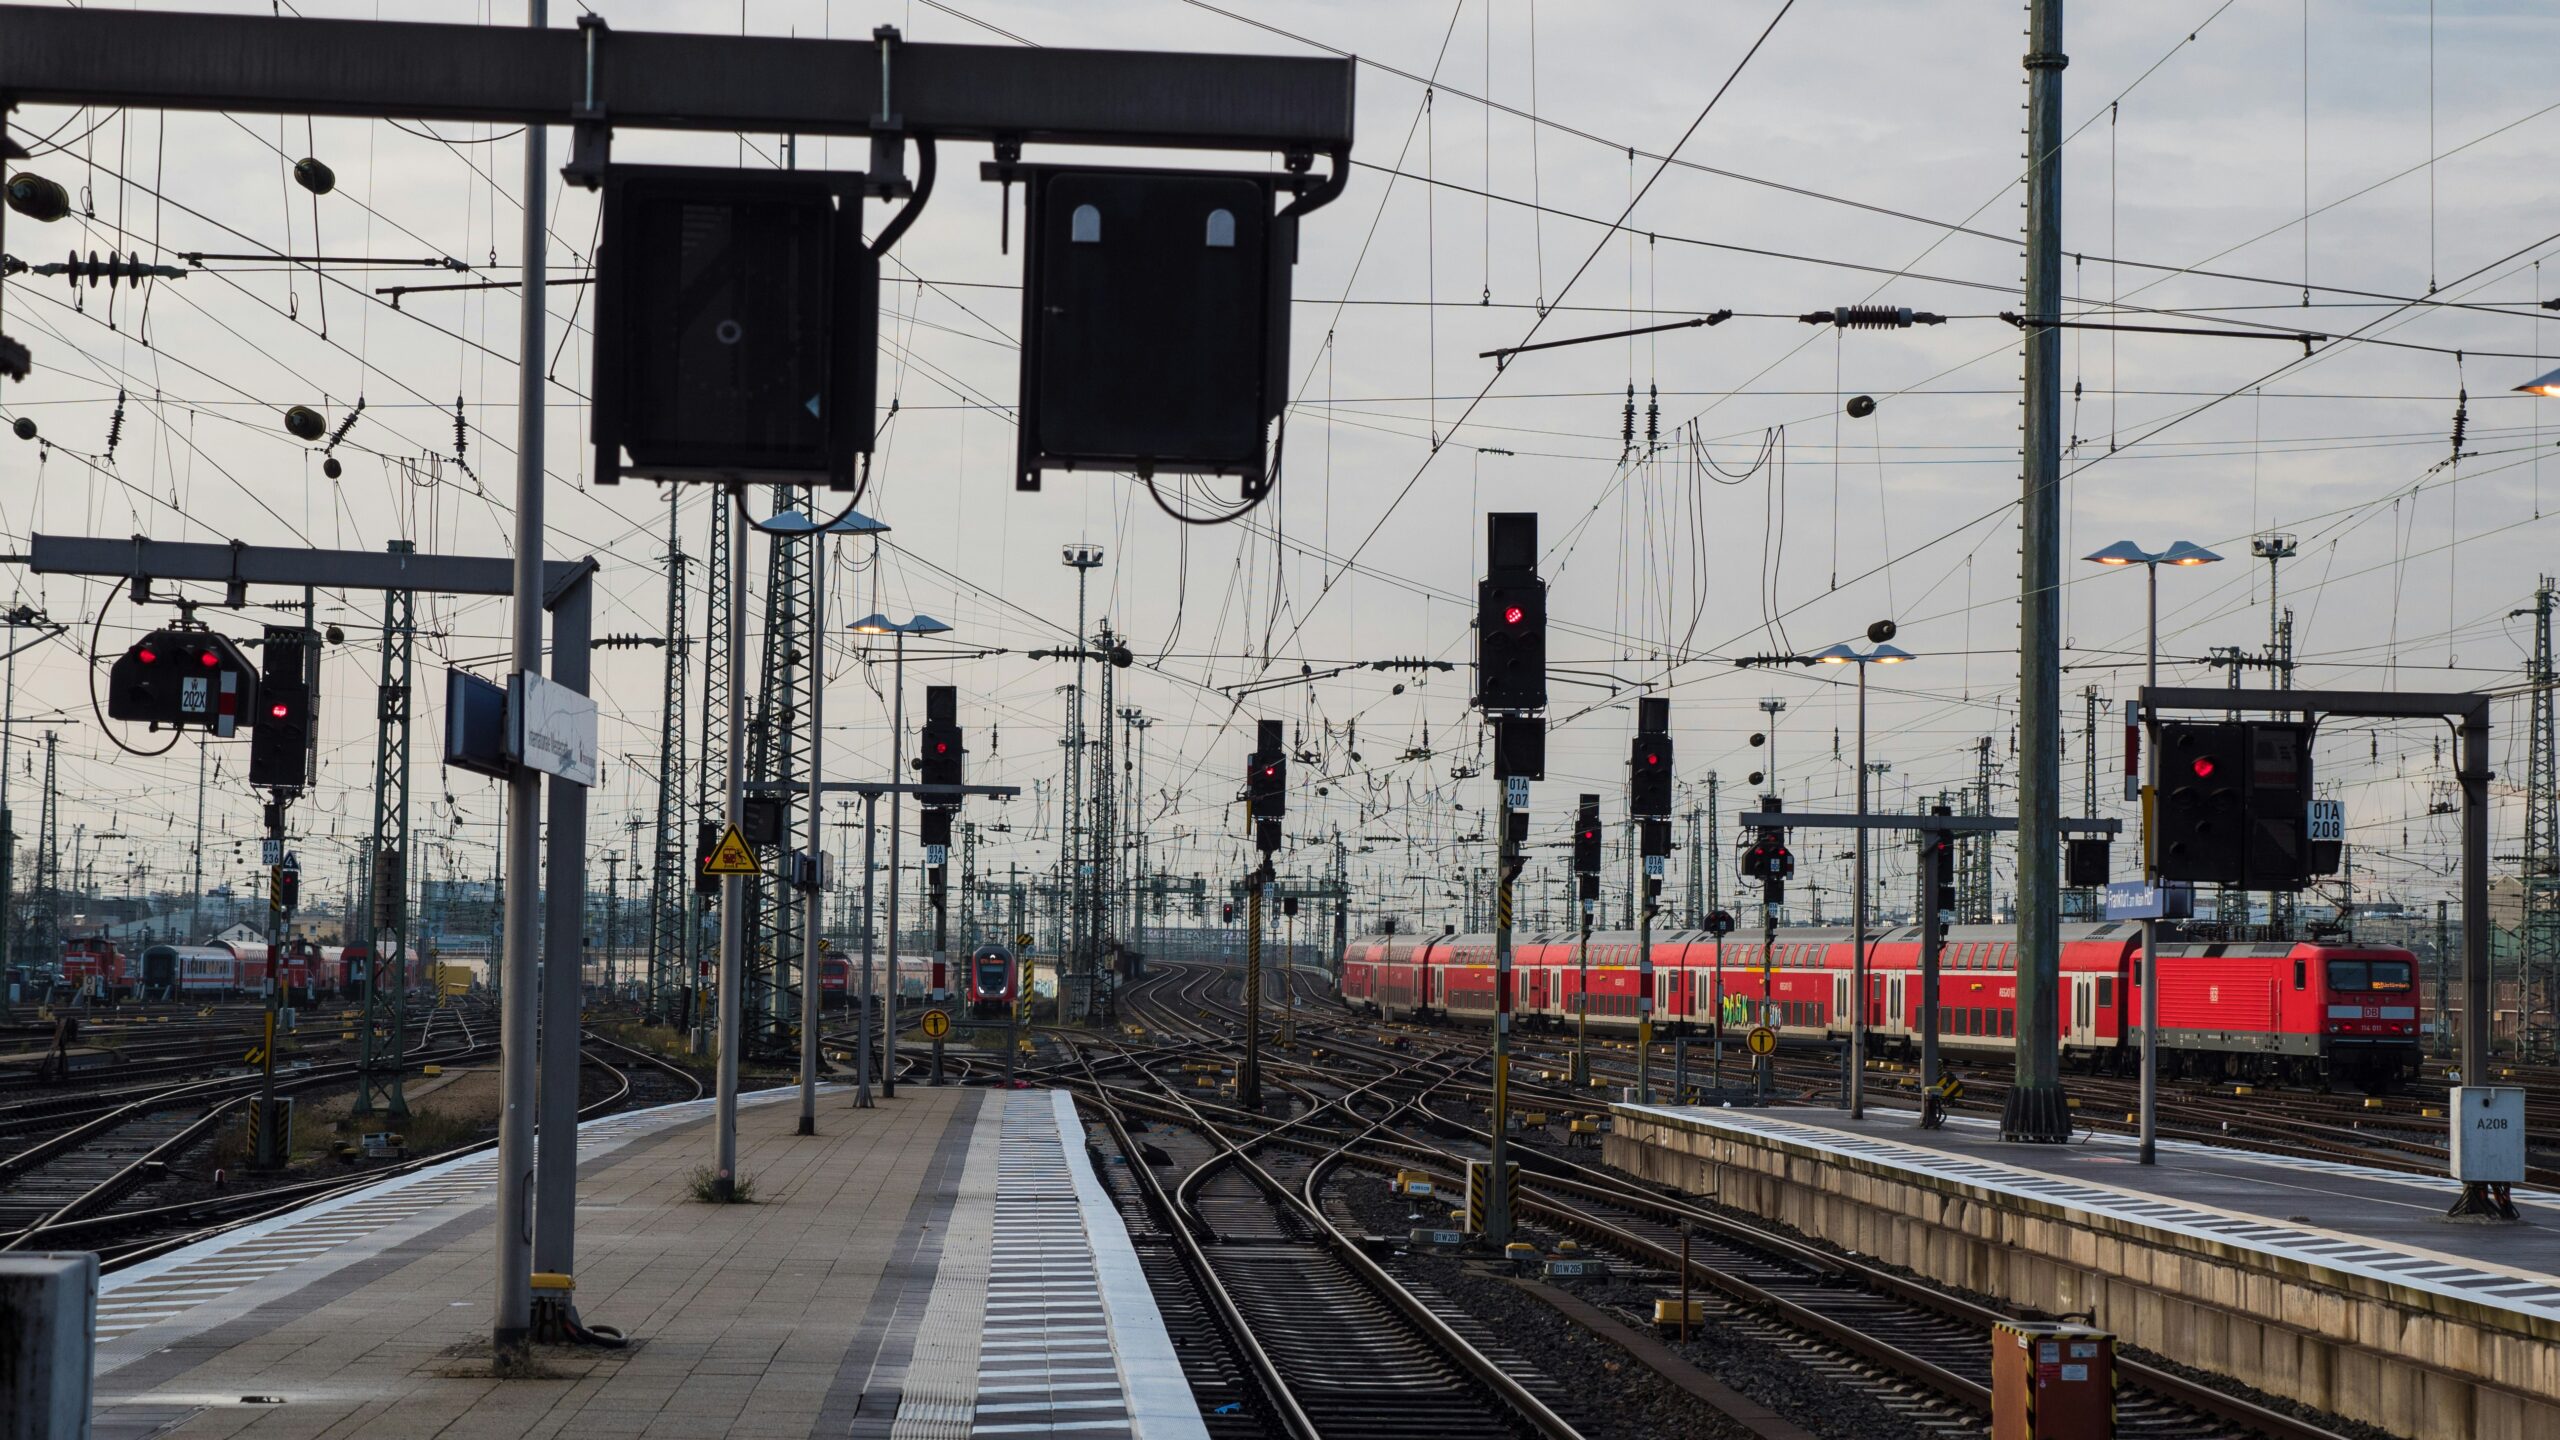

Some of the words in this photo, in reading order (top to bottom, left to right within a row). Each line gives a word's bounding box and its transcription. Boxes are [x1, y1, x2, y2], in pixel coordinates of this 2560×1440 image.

[192, 682, 198, 690] W
[183, 691, 206, 707] 202X
[1510, 778, 1528, 790] 01A
[1508, 794, 1528, 806] 207
[2314, 802, 2340, 820] 01A
[2312, 821, 2340, 838] 208
[263, 842, 278, 851] 01A
[930, 846, 943, 854] 01A
[263, 854, 279, 864] 236
[285, 857, 293, 867] 4
[929, 855, 943, 863] 226
[1649, 856, 1662, 865] 01A
[1648, 866, 1662, 874] 228
[2108, 889, 2129, 908] Frankfurt
[2365, 1008, 2378, 1017] DB
[2477, 1118, 2508, 1130] A208
